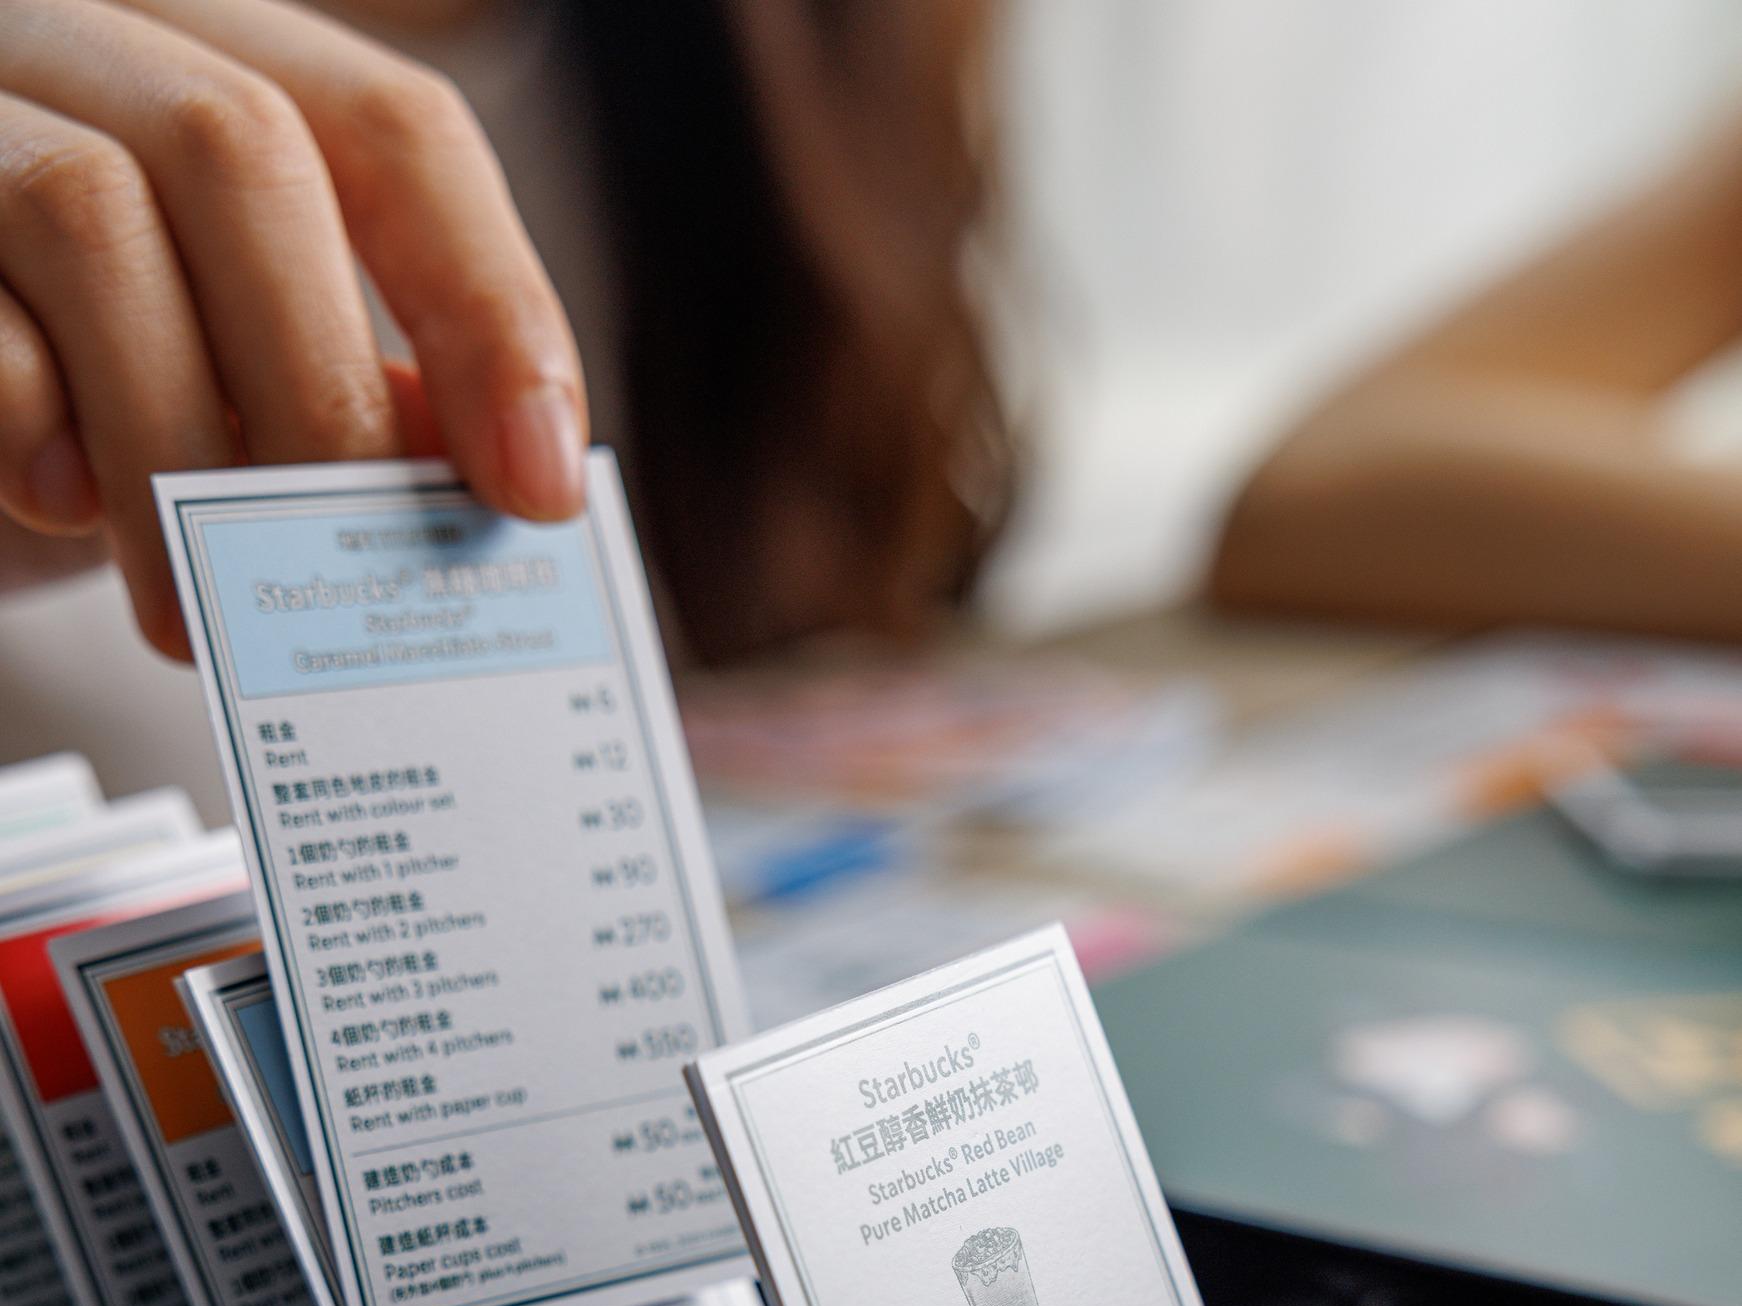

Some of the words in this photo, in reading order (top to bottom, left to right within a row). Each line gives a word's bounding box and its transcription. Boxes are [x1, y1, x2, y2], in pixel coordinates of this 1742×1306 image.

[265, 749, 308, 768] Rent
[279, 809, 324, 829] Rent
[327, 802, 367, 824] with
[293, 871, 337, 891] Rent
[342, 863, 381, 885] with
[307, 932, 352, 952] Rent
[356, 923, 395, 946] with
[399, 921, 411, 940] 2
[415, 911, 487, 939] pitchers
[322, 993, 365, 1012] Rent
[370, 983, 410, 1006] with
[414, 980, 424, 999] 3
[428, 970, 499, 999] pitchers
[336, 1053, 379, 1073] Rent
[384, 1043, 424, 1066] with
[428, 1039, 439, 1056] 4
[442, 1029, 514, 1057] pitchers
[350, 1112, 393, 1133] Rent
[398, 1101, 438, 1124] with
[441, 1093, 491, 1119] paper
[829, 1058, 1040, 1175] 紅豆醇香鮮奶抹茶邨
[961, 1133, 994, 1165] Red
[995, 1120, 1037, 1151] Bean
[369, 1186, 442, 1216] Pitchers
[859, 1216, 903, 1246] Pure
[903, 1187, 967, 1228] Matcha
[967, 1165, 1010, 1199] Latte
[1009, 1141, 1065, 1178] Village
[384, 1258, 436, 1281] Paper
